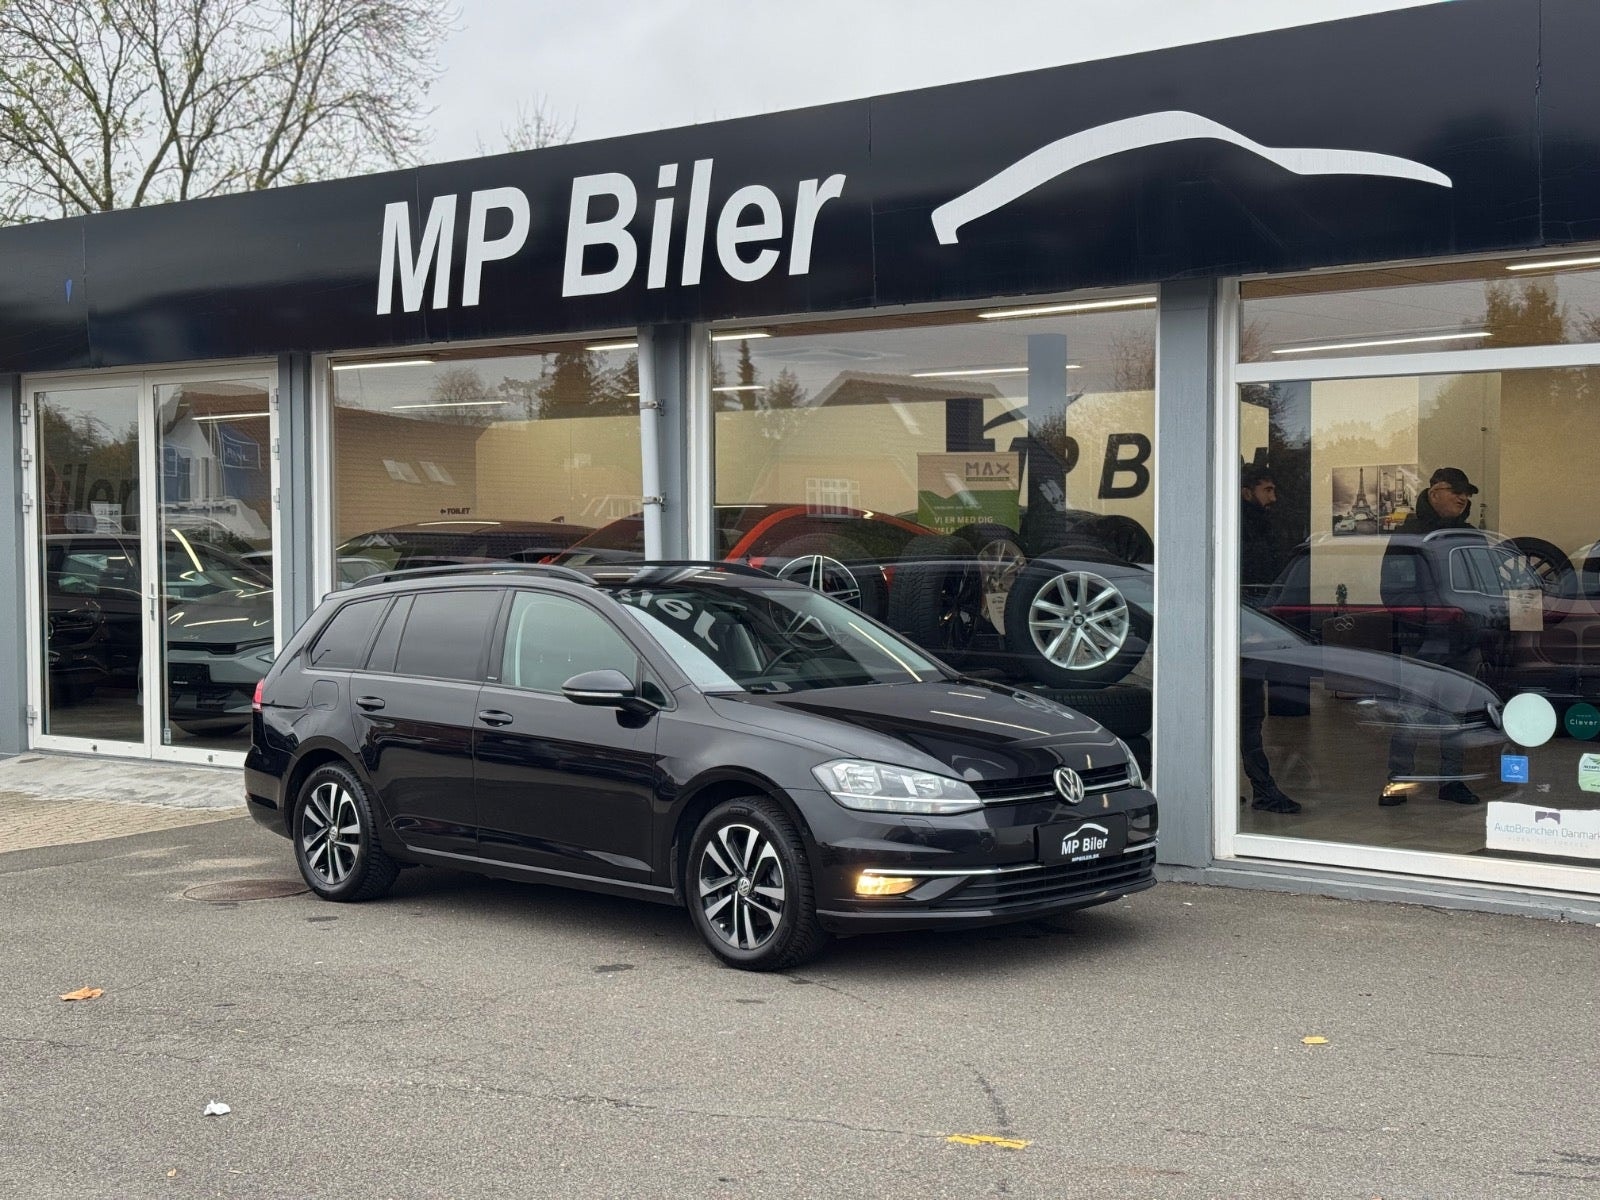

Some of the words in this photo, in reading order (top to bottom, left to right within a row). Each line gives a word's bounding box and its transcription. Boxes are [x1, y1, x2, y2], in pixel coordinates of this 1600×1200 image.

[377, 187, 530, 315] MP
[562, 158, 847, 298] Biler
[965, 461, 1010, 476] MAX
[447, 507, 471, 515] TOILET
[934, 515, 943, 524] VI
[957, 515, 976, 524] MED
[978, 515, 994, 524] DIG
[1569, 718, 1598, 727] Clever
[1494, 822, 1559, 837] AutoBranchen
[1061, 839, 1080, 855] MP
[1082, 836, 1108, 852] Biler
